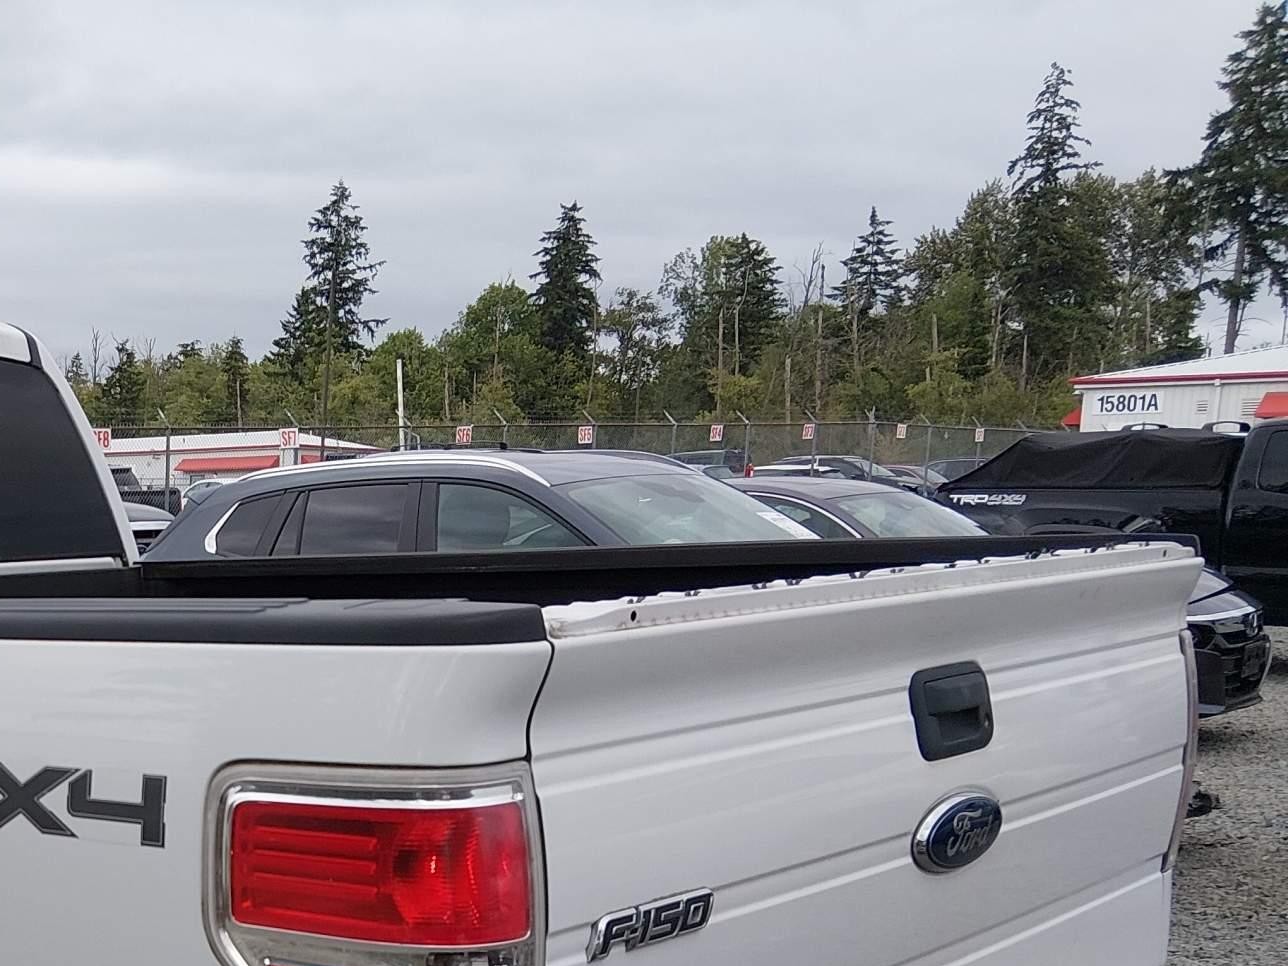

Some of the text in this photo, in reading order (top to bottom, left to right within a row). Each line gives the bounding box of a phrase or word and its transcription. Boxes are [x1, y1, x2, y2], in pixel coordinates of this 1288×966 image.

[1097, 393, 1159, 413] 15801A
[281, 430, 297, 447] SF7
[456, 427, 471, 443] SF6
[579, 427, 592, 442] SF5
[946, 808, 994, 857] Ford
